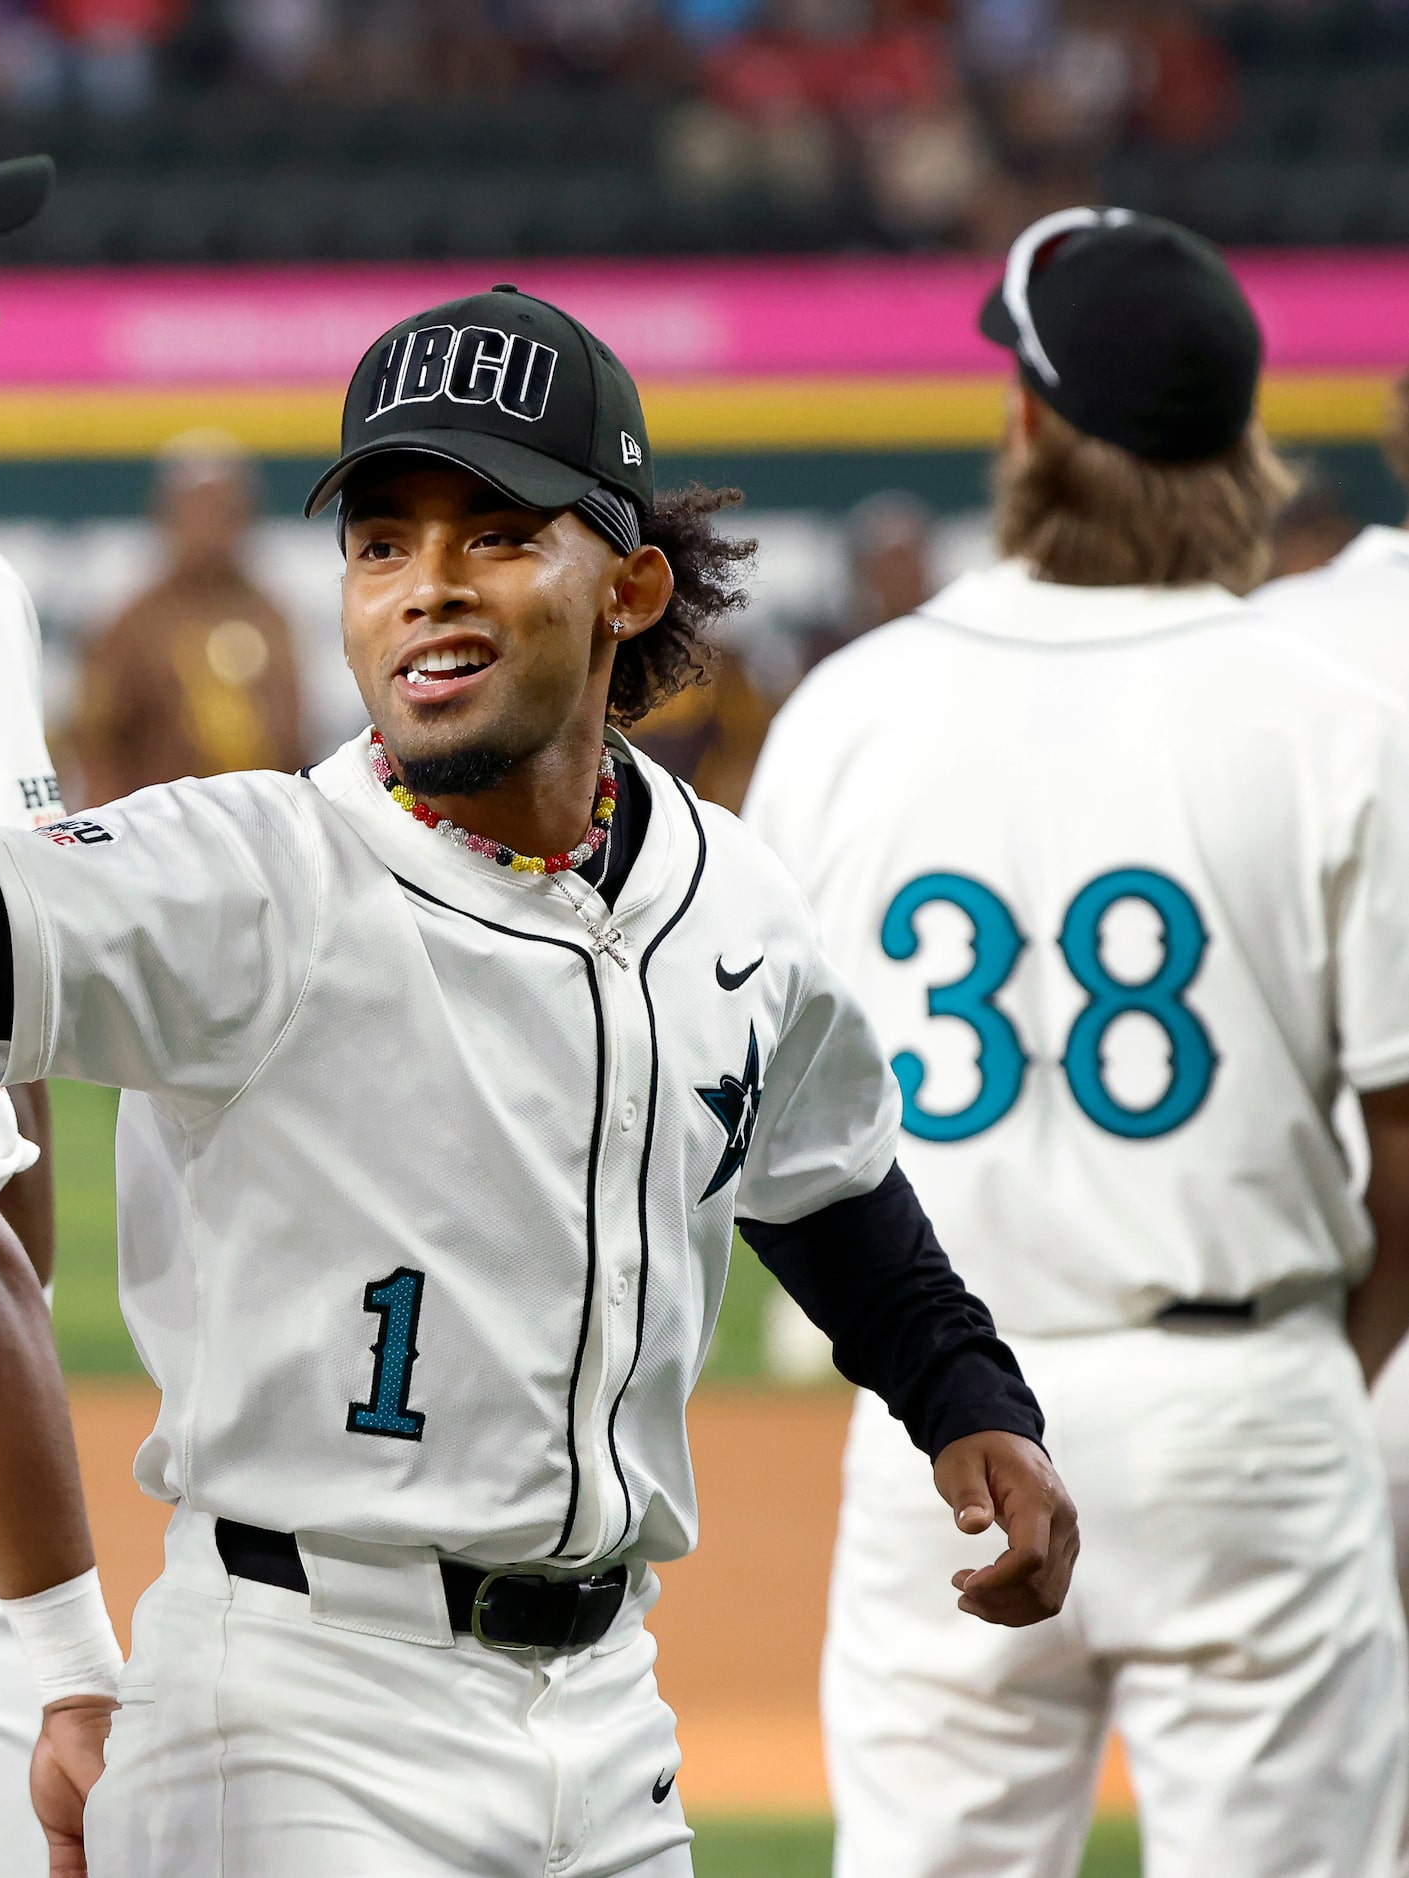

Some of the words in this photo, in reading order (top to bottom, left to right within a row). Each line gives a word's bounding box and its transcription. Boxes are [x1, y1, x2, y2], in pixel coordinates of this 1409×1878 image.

[365, 324, 559, 422] HBCU
[881, 867, 1219, 1143] 38
[346, 1266, 426, 1442] 1
